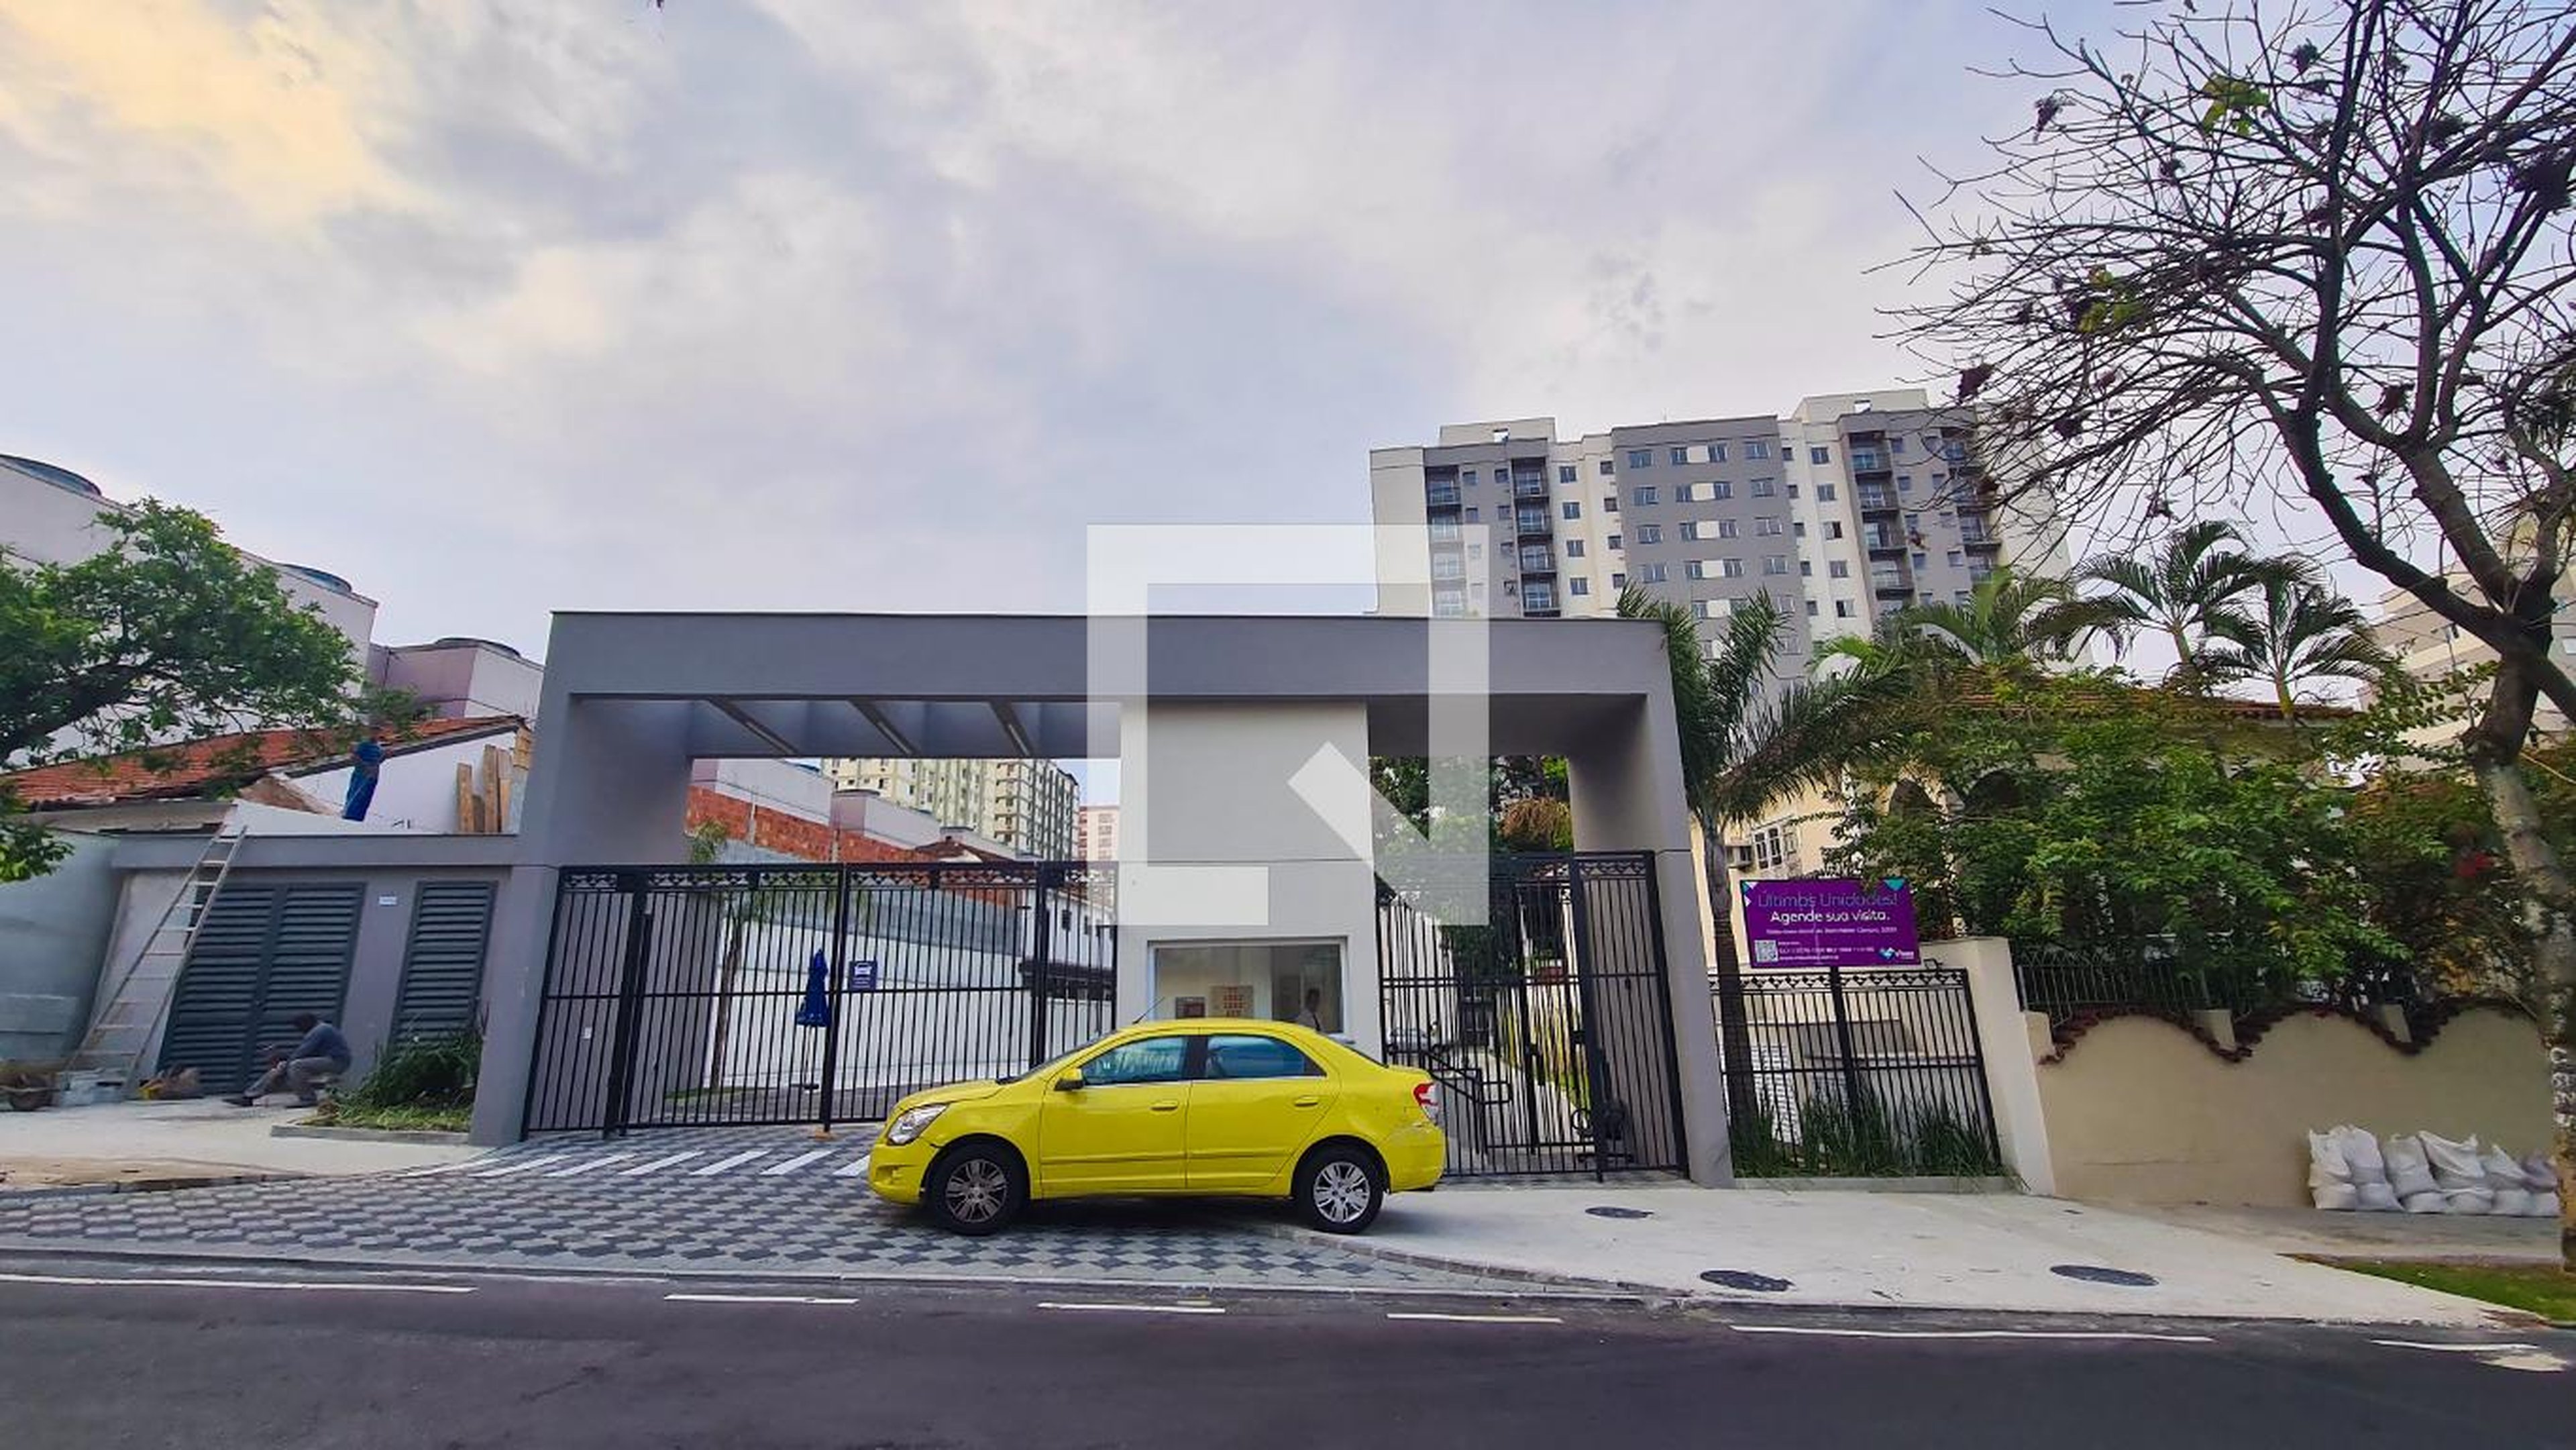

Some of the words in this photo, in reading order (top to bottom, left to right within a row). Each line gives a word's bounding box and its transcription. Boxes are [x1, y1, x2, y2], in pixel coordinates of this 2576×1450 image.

[1770, 911, 1823, 925] Agende
[1825, 913, 1849, 922] sua
[1851, 909, 1890, 921] visita.
